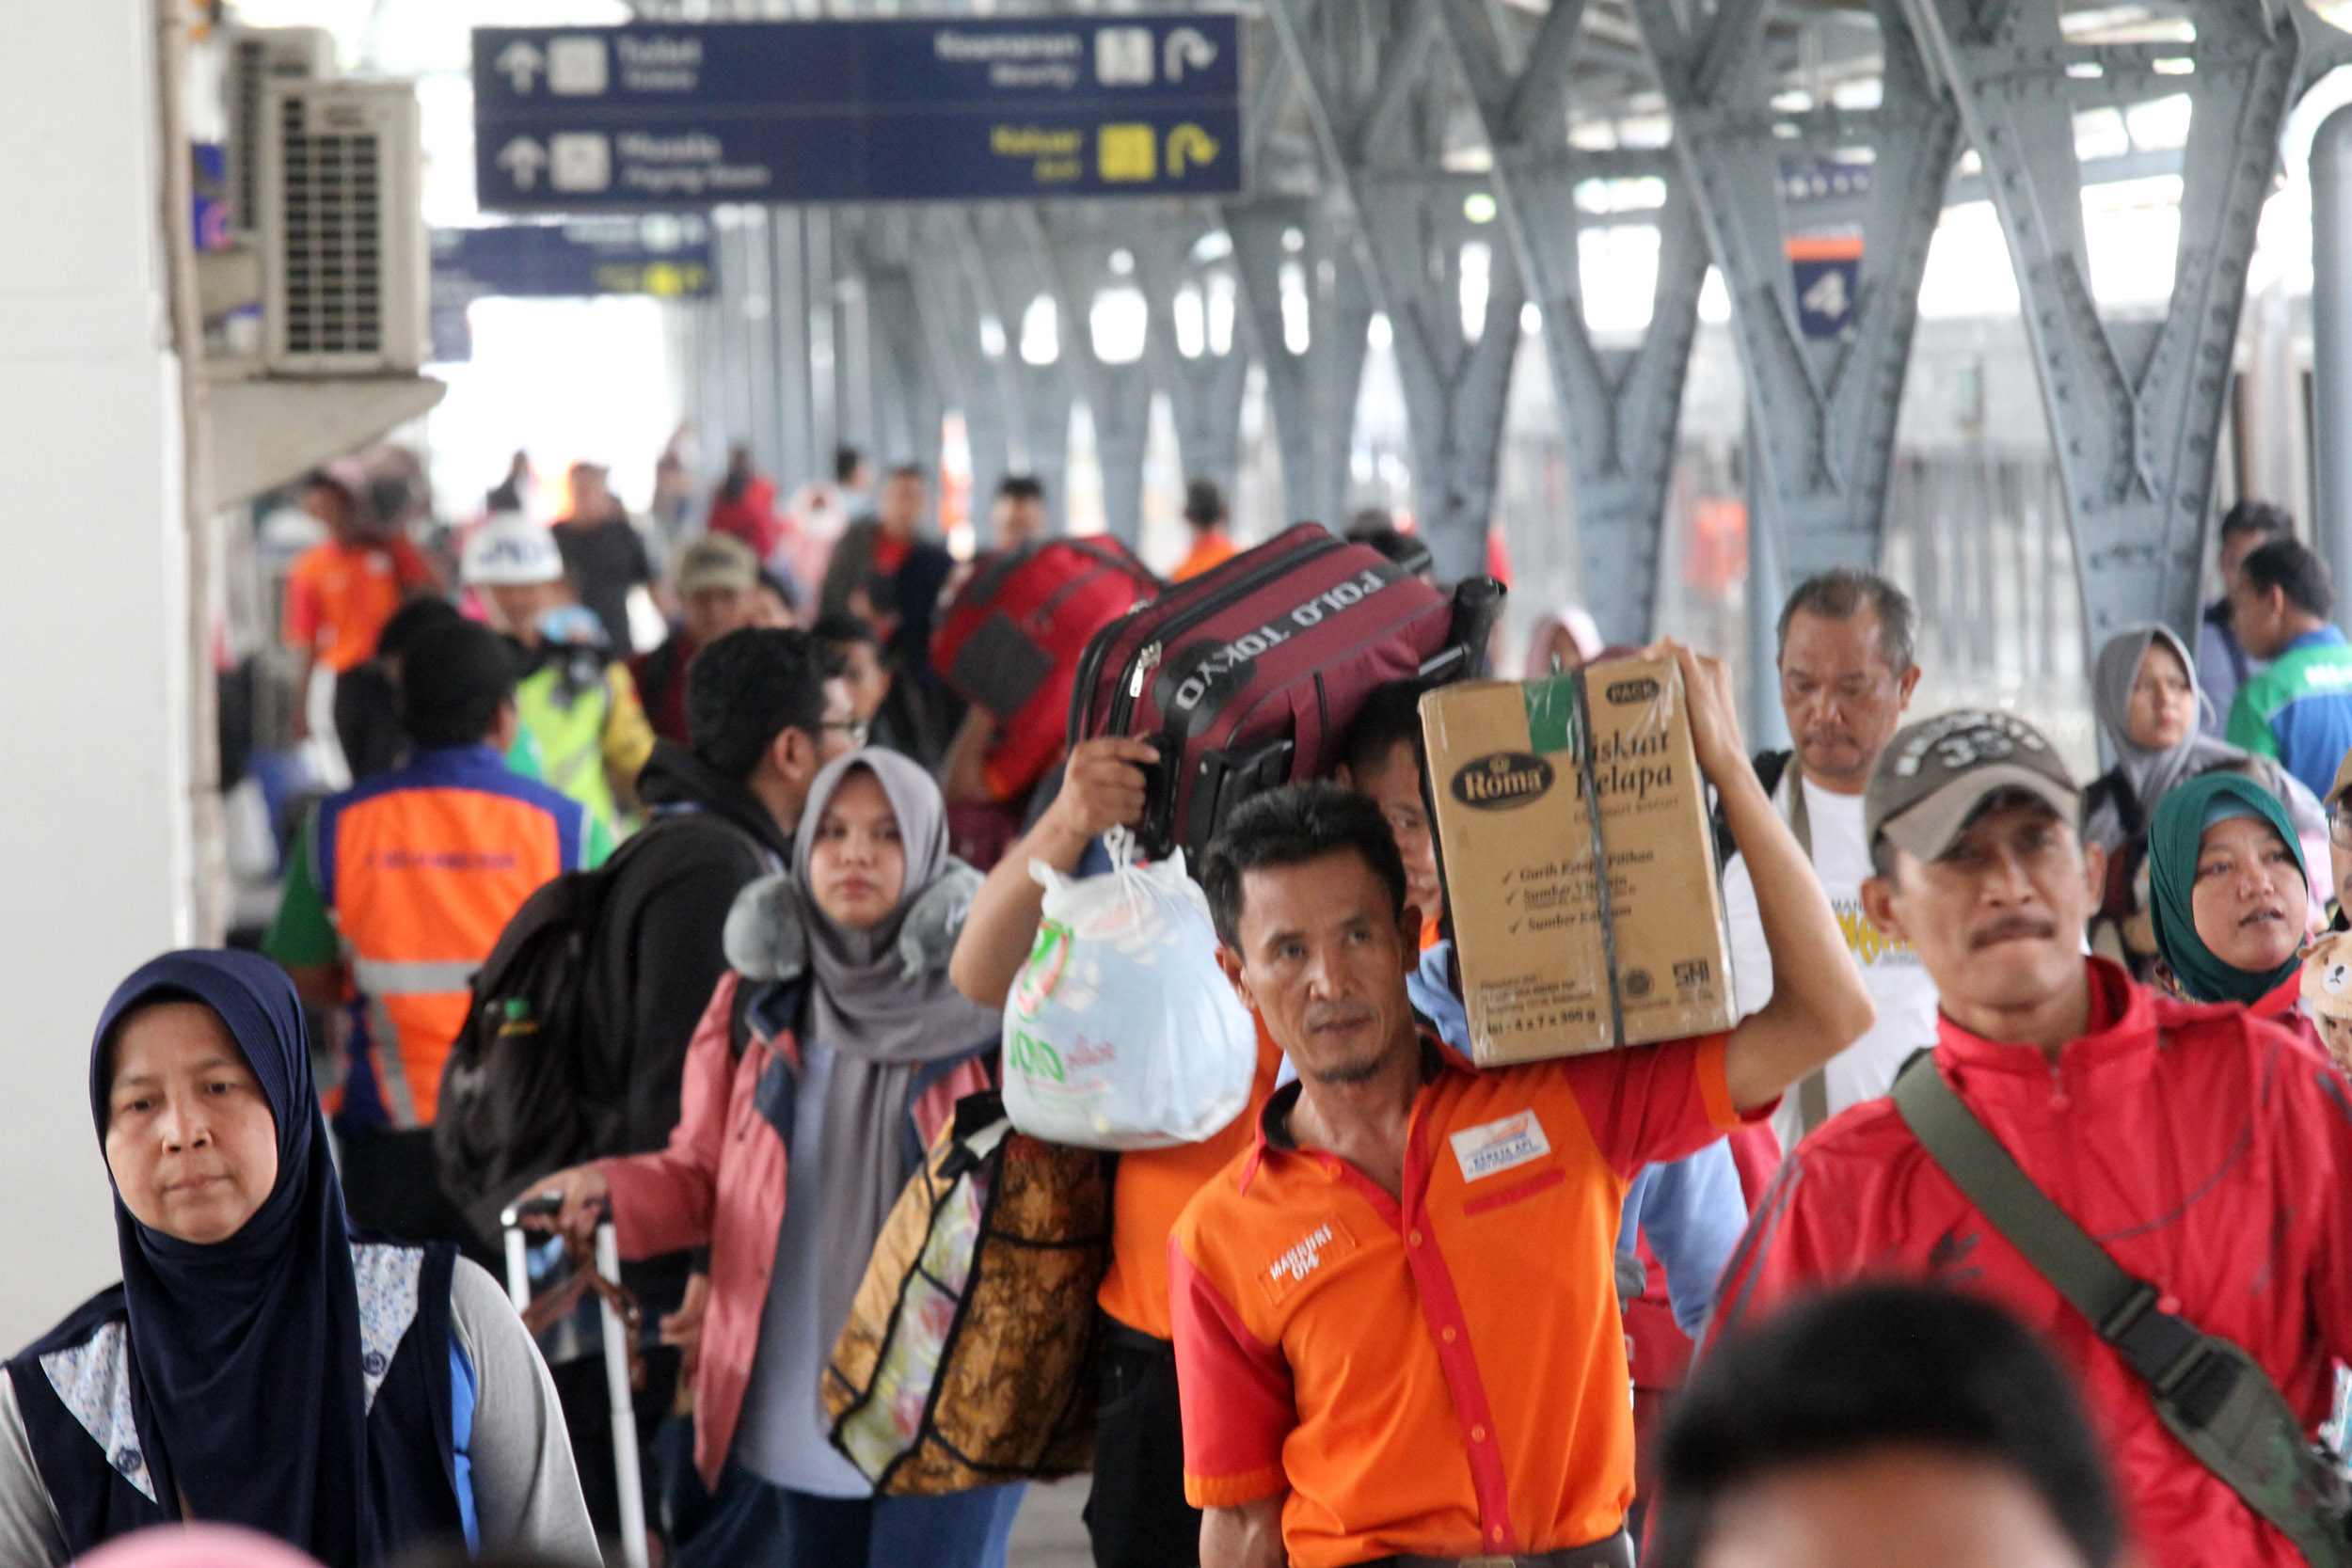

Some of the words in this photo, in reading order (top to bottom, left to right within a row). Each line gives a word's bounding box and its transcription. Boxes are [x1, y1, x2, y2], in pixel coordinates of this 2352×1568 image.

[1802, 270, 1849, 318] 4
[1292, 570, 1385, 627] POLO
[1176, 626, 1290, 711] TOKYO
[1572, 728, 1669, 768] iskuit
[1465, 770, 1543, 801] Roma
